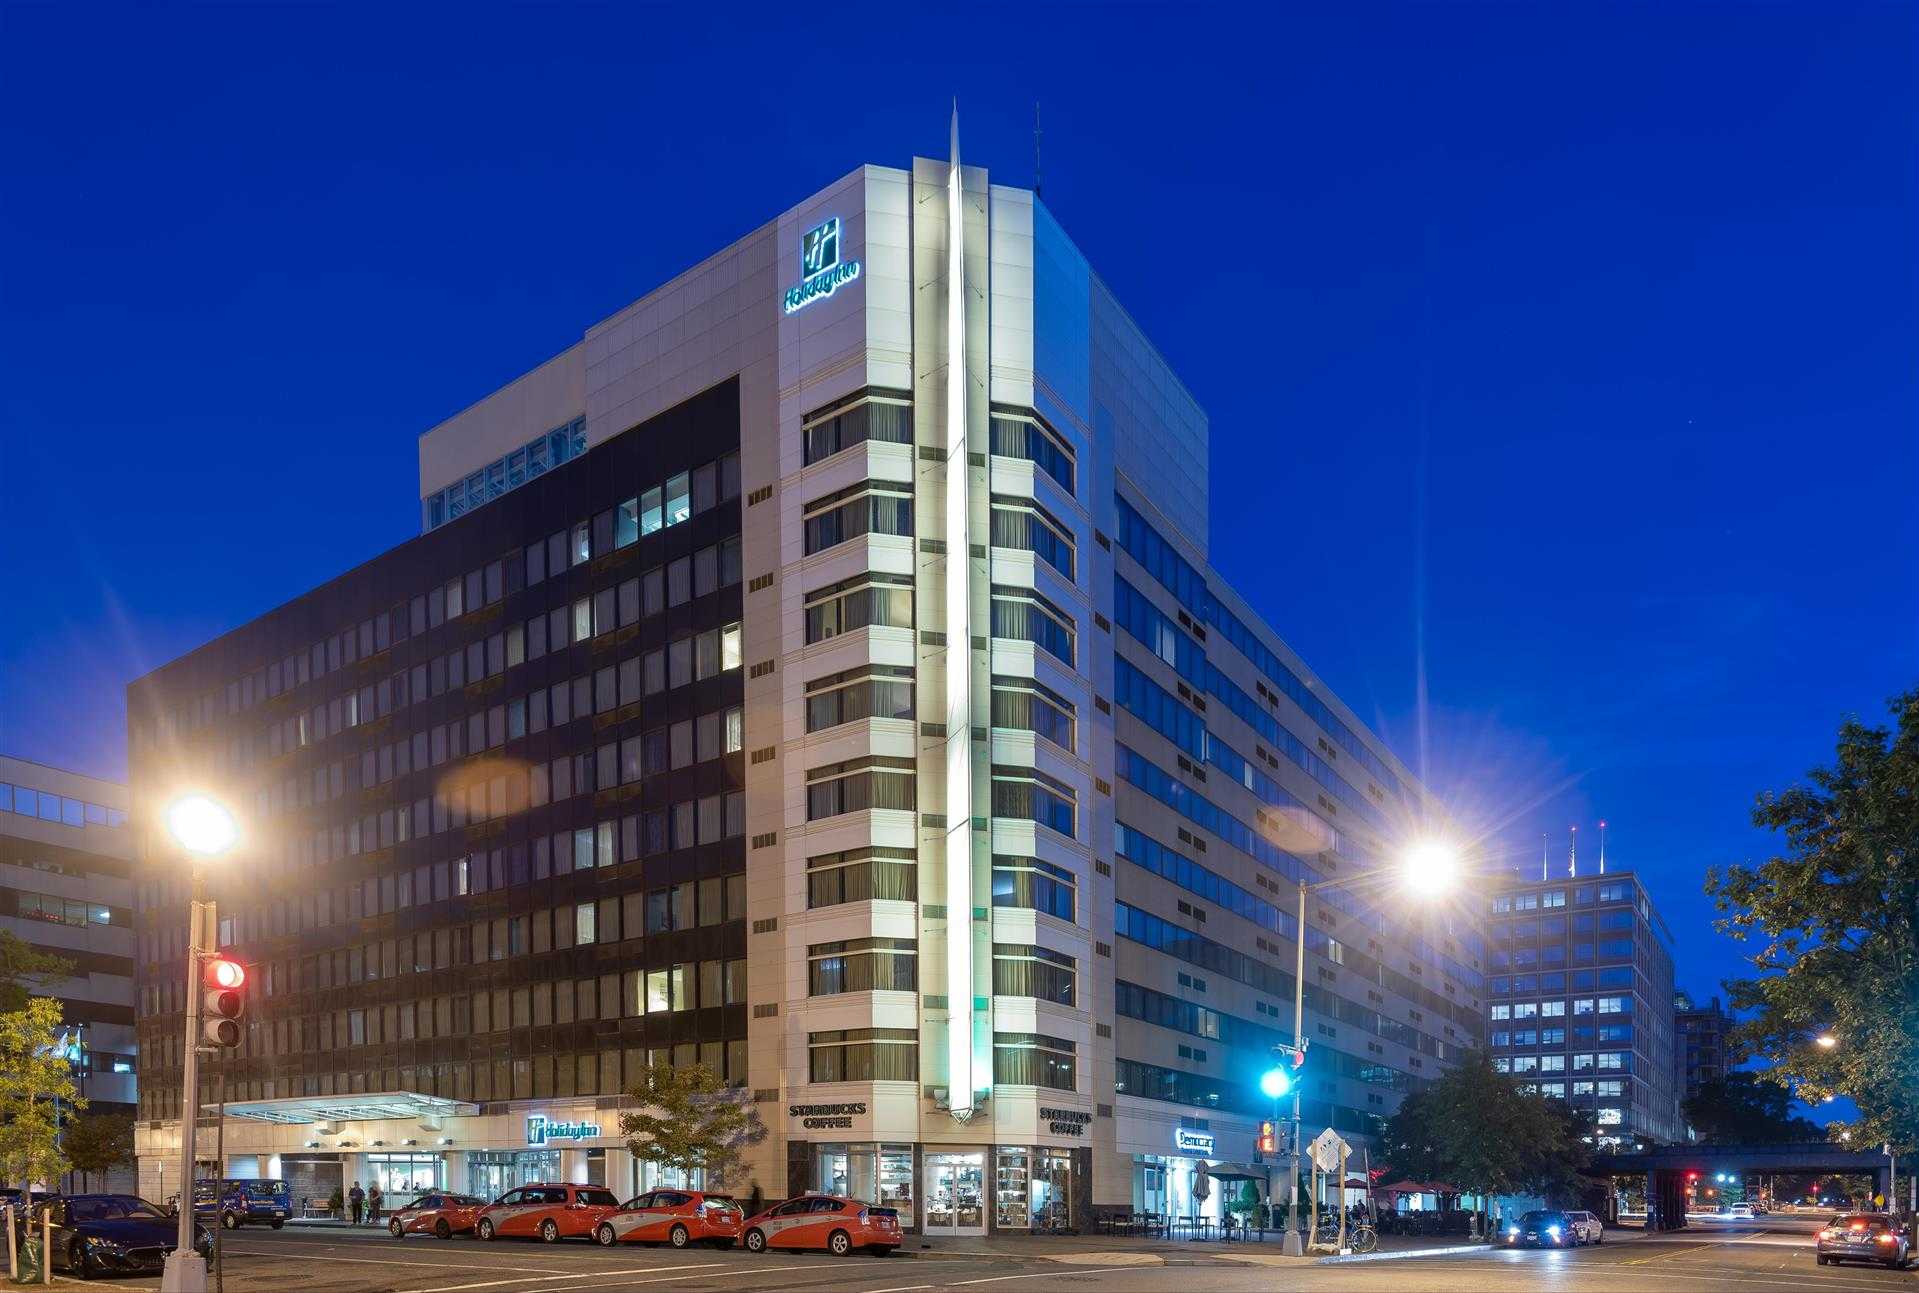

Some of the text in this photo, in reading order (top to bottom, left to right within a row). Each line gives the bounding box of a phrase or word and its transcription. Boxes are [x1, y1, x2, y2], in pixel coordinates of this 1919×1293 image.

[784, 262, 859, 312] Holiday Inn
[789, 1102, 867, 1117] STARBUCKS
[545, 1120, 598, 1140] Holiday Inn
[803, 1117, 852, 1129] COFFEE
